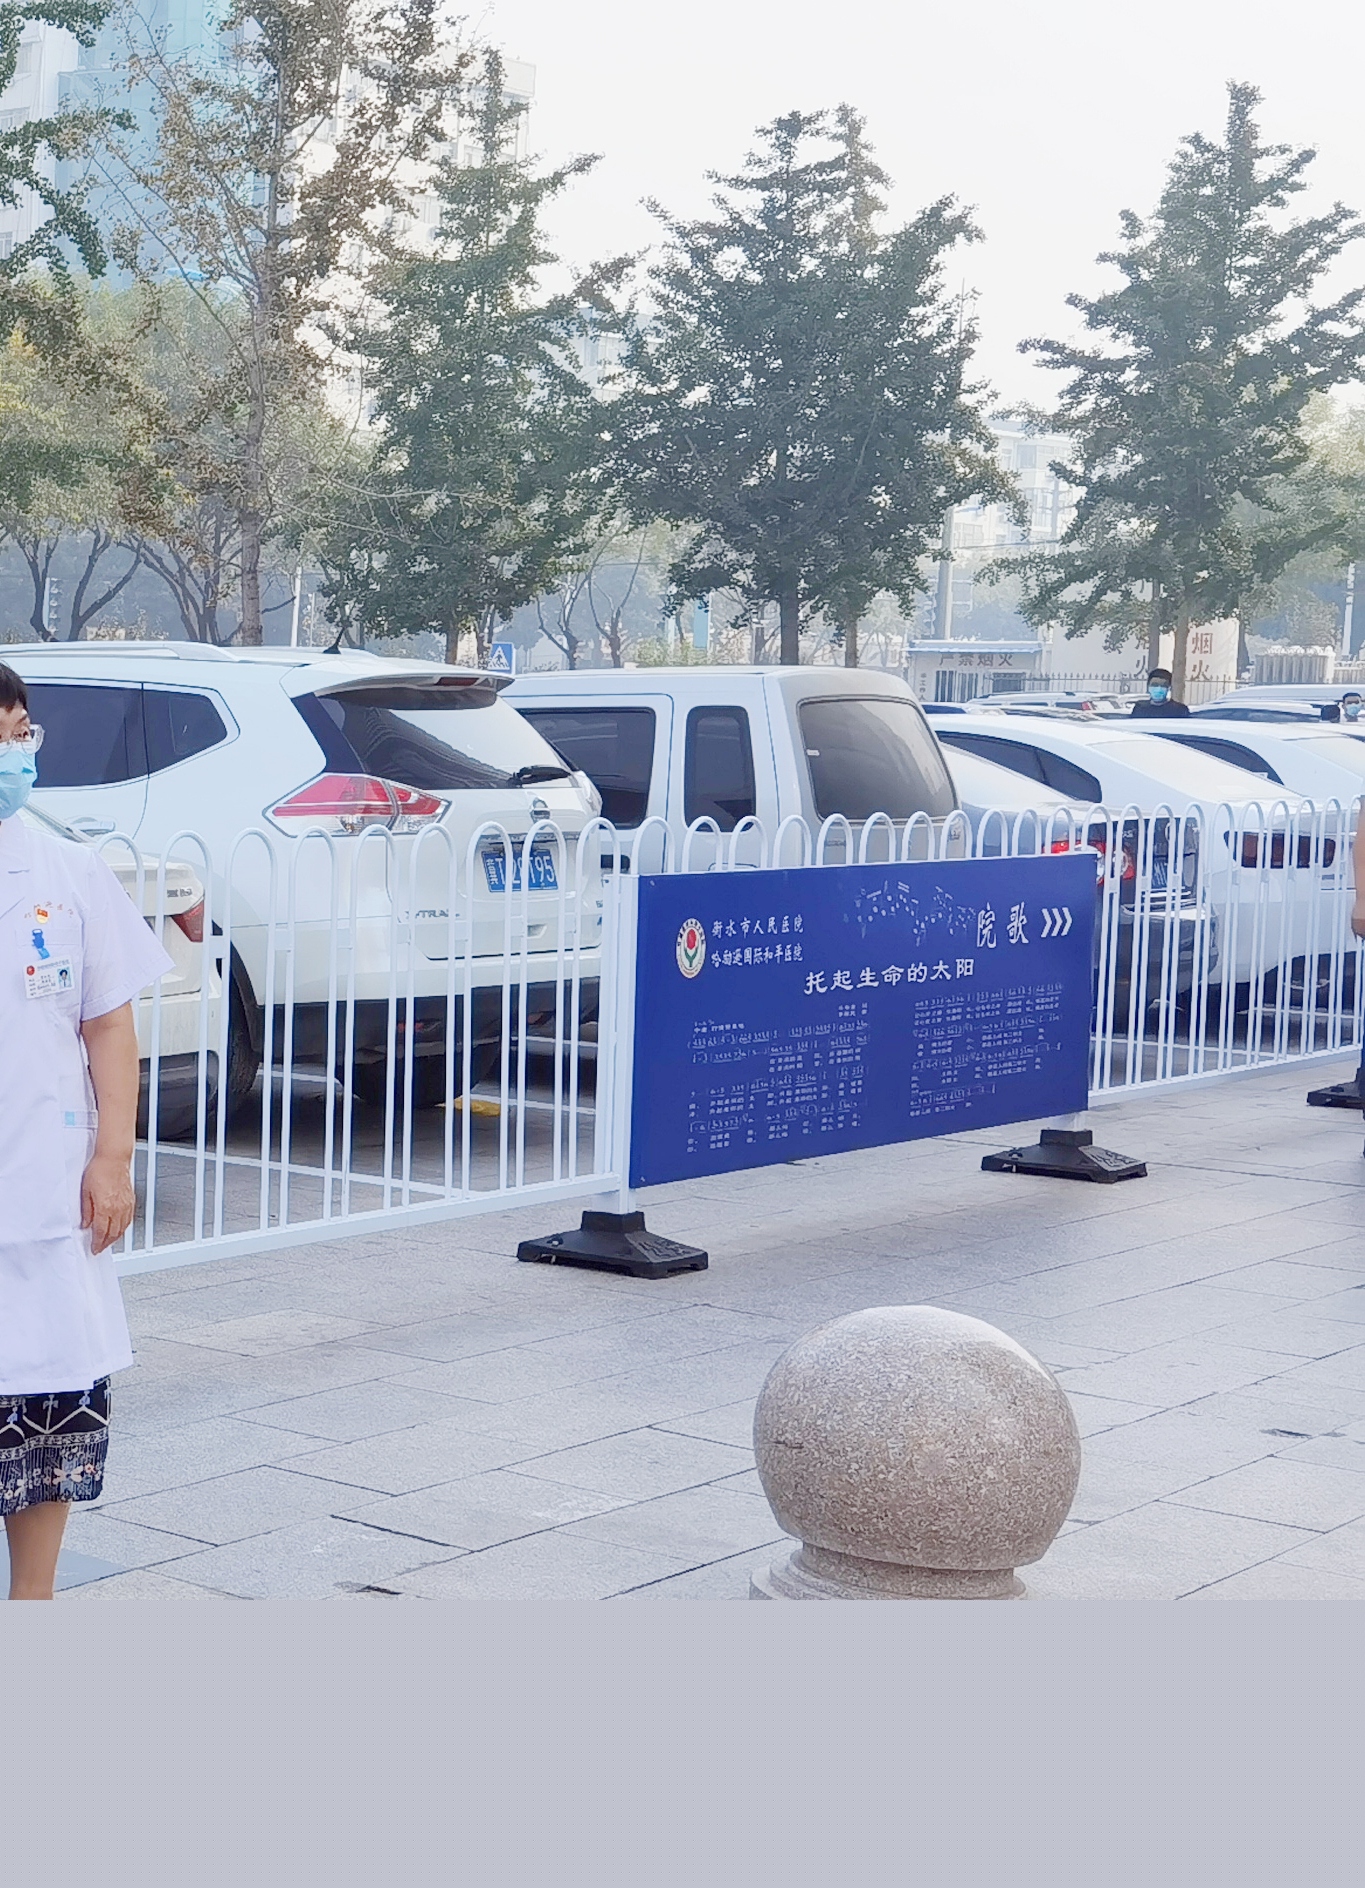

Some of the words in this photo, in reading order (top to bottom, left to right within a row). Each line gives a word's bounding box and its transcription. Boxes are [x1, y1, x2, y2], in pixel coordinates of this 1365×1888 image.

[711, 913, 804, 939] 衡水市人民医院
[976, 902, 1029, 949] 院歌
[804, 958, 975, 995] 托起生命的太阳
